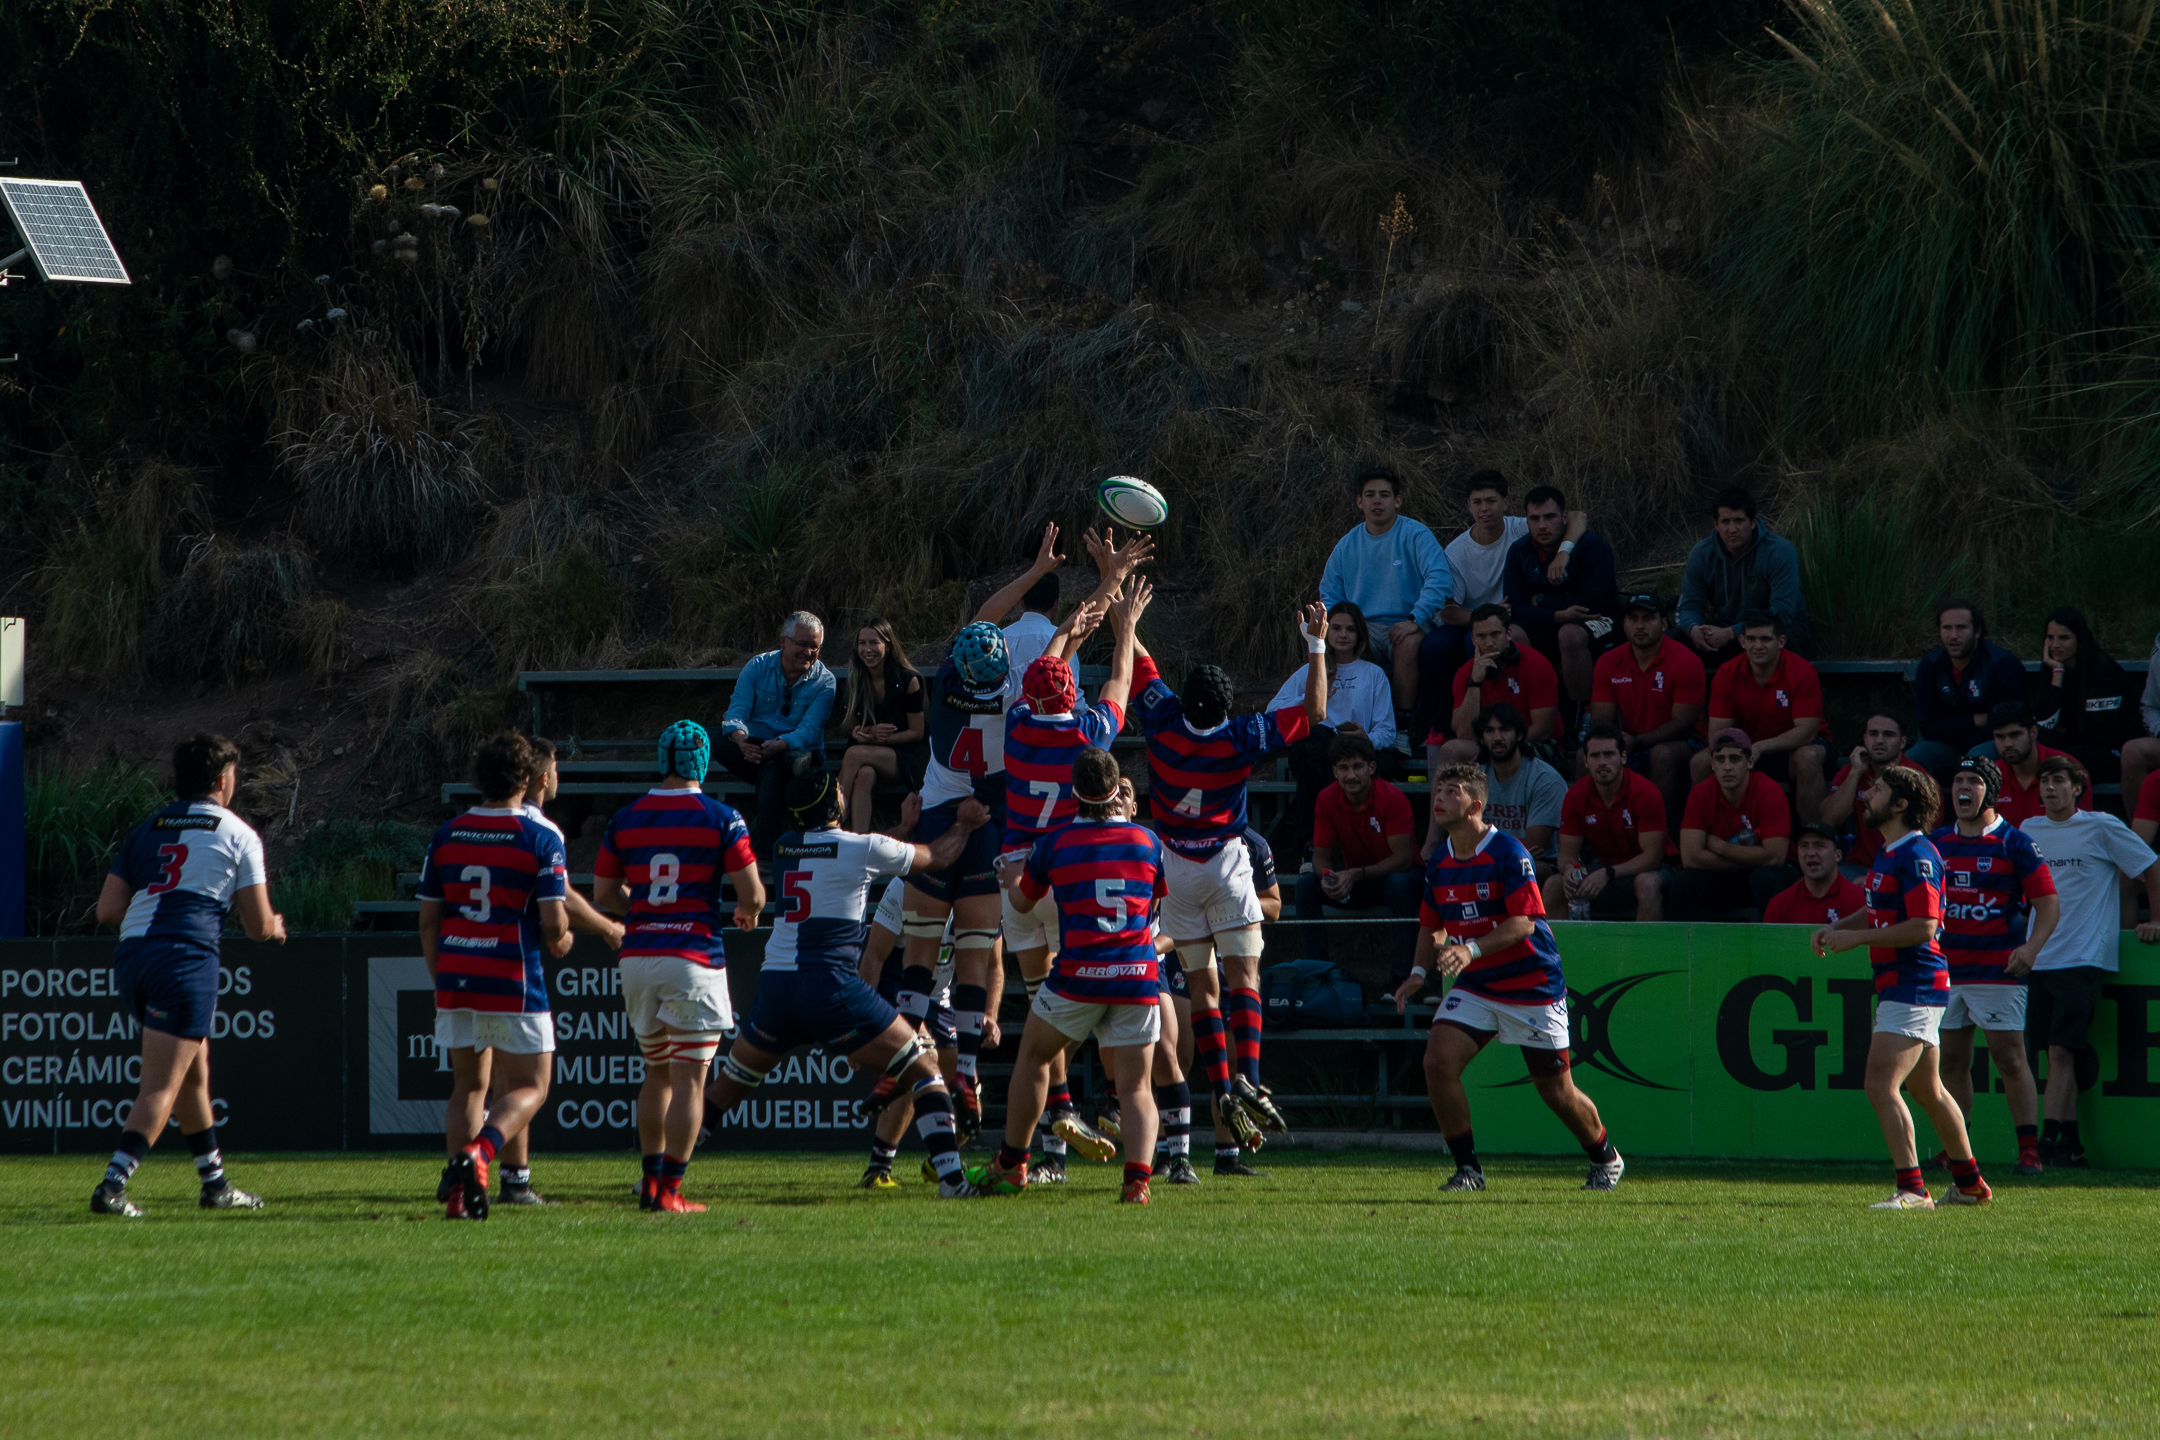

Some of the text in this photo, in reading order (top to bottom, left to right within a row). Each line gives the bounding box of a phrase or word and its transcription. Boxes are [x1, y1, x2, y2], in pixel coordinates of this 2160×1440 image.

[949, 726, 988, 778] 4
[1029, 780, 1061, 828] 7
[1173, 788, 1203, 818] 4
[148, 842, 188, 895] 3
[648, 853, 680, 907] 8
[459, 865, 491, 923] 3
[783, 870, 813, 923] 5
[1095, 878, 1127, 933] 5
[1947, 903, 1988, 921] aro
[2, 966, 252, 998] PORCELOS
[556, 967, 622, 997] GRIF
[1075, 964, 1147, 978] AEROVAN
[2, 1048, 143, 1085] CERÁMIC
[557, 1055, 646, 1084] MUEB
[765, 1048, 854, 1084] BAÑO
[2, 1092, 137, 1128] VINÍLICO
[557, 1099, 869, 1129] COCI MUEBLES
